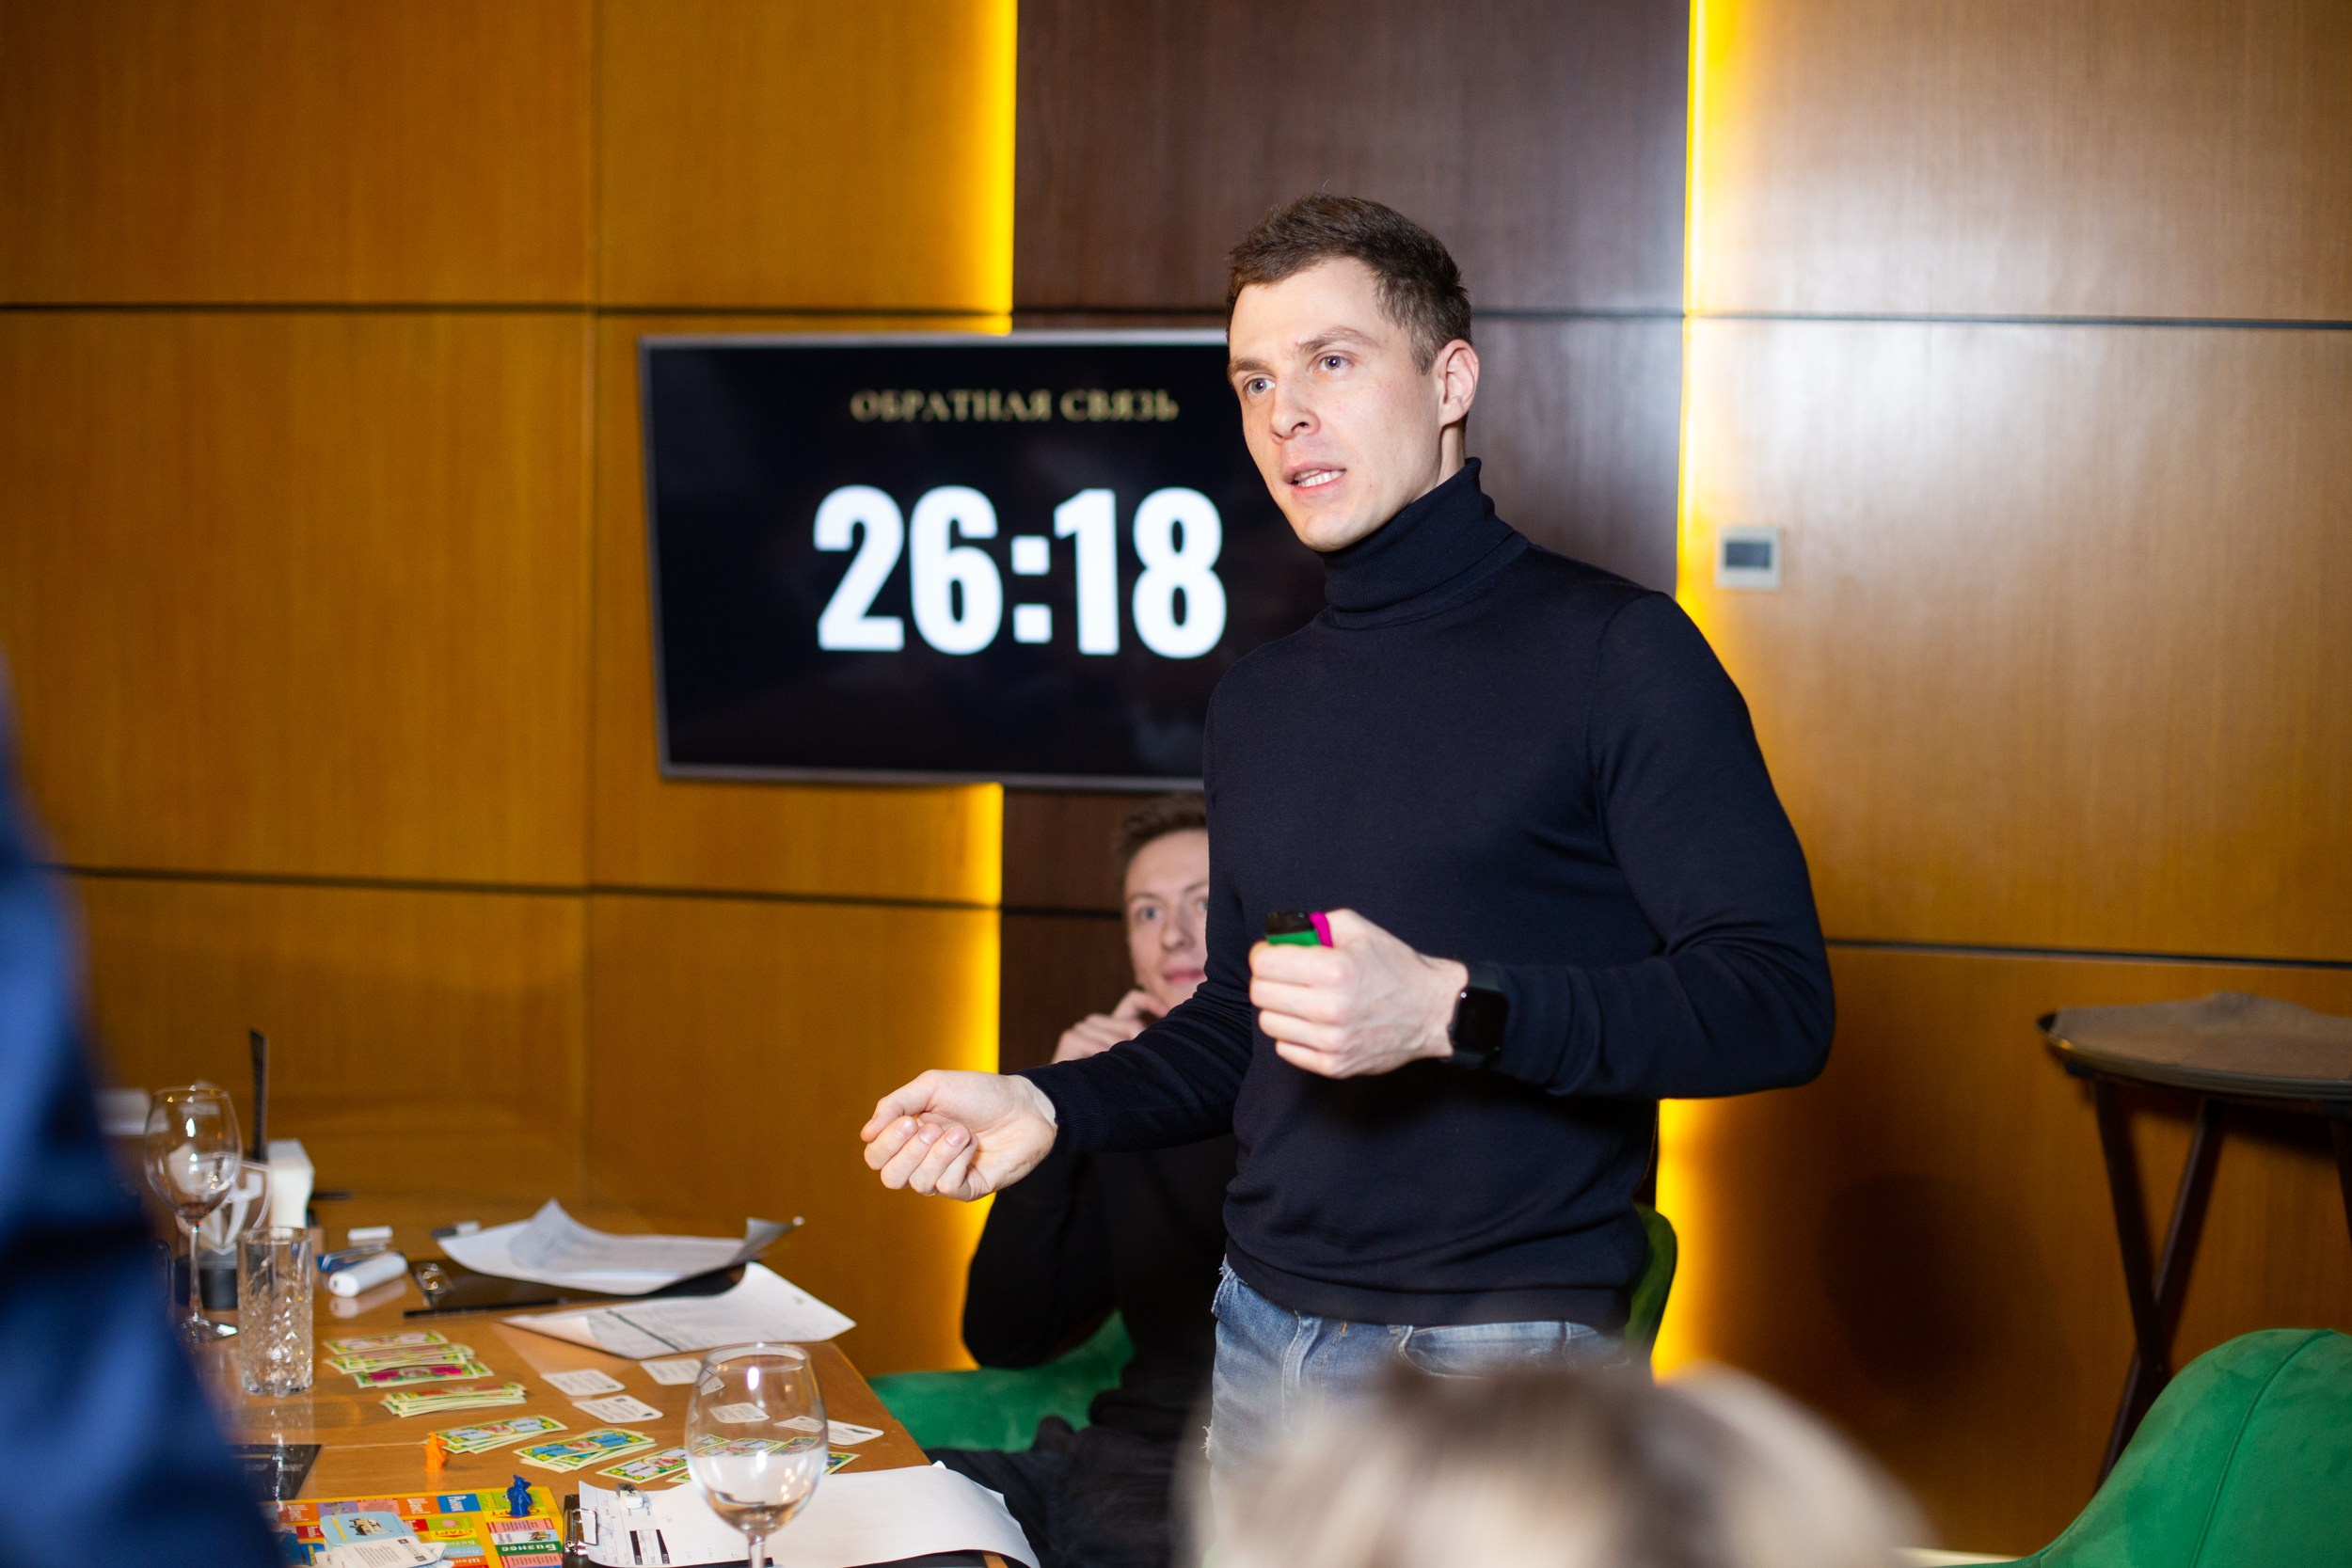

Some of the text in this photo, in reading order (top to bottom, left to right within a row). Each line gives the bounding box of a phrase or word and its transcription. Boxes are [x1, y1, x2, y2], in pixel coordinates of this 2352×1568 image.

[850, 388, 1180, 422] ОБРАТНАЯ СВЯЗЬ
[813, 484, 1227, 658] 26:18
[490, 1509, 540, 1517] СРТ
[501, 1544, 557, 1552] Бизнес
